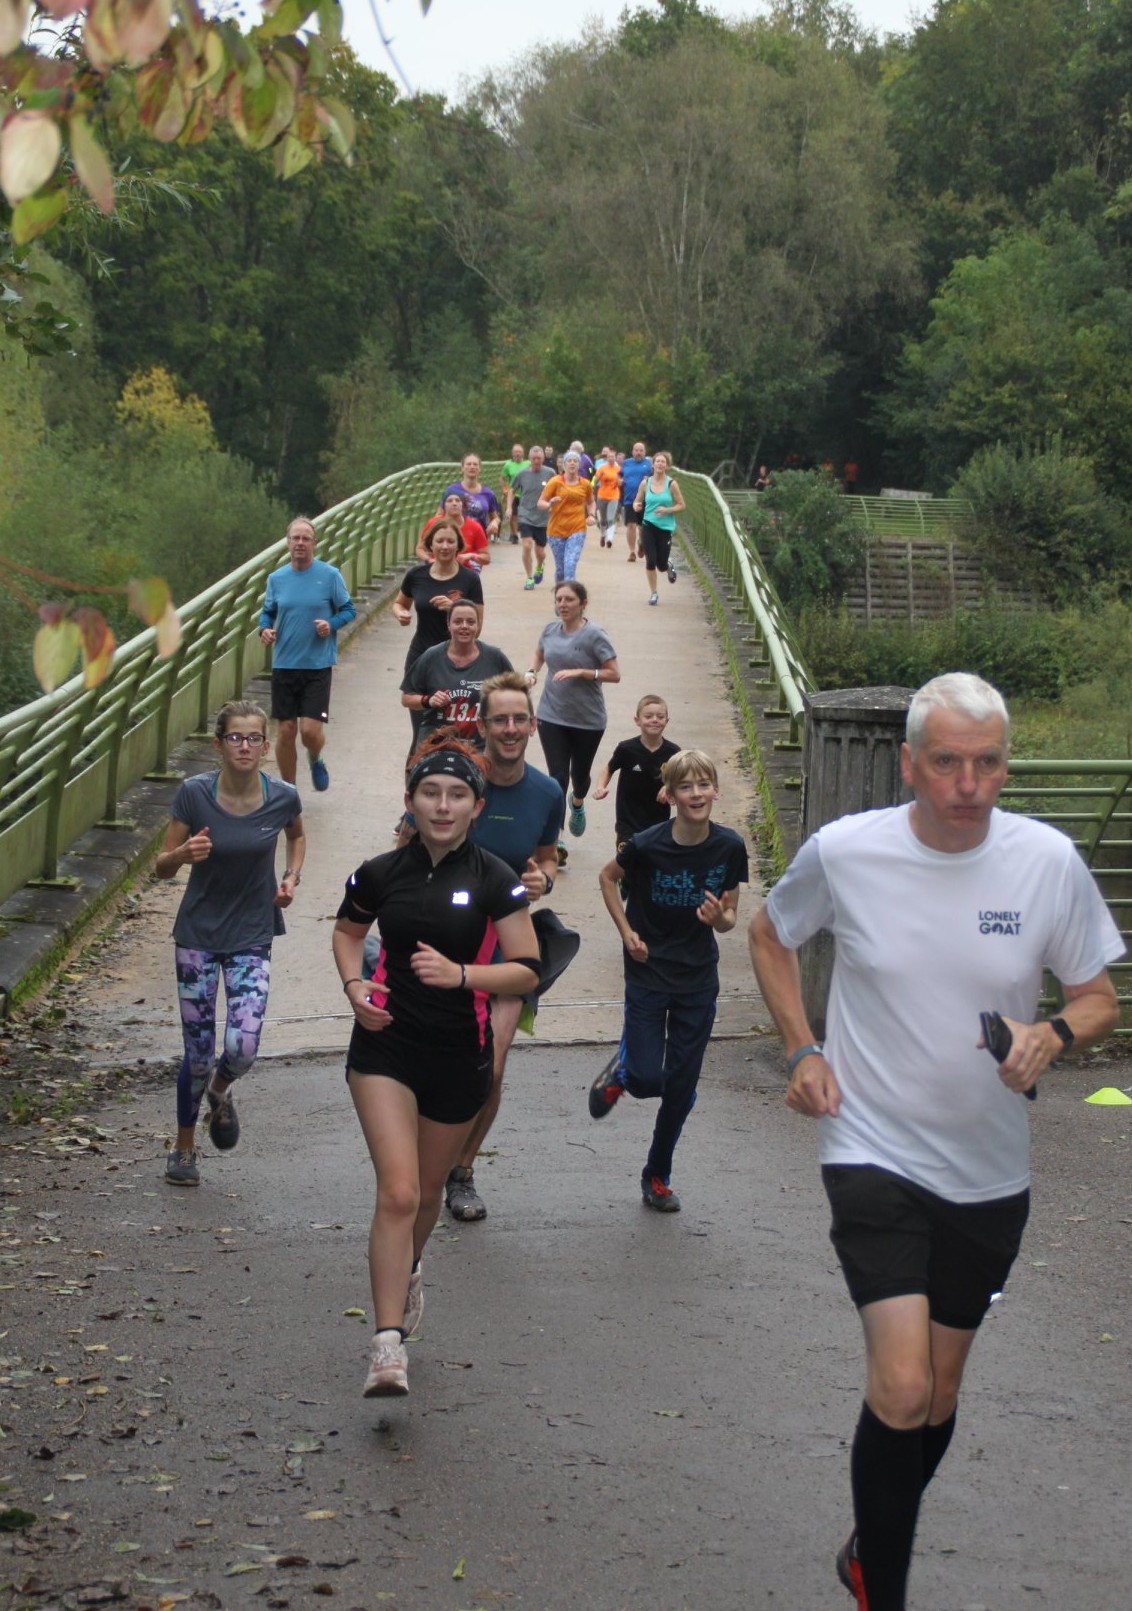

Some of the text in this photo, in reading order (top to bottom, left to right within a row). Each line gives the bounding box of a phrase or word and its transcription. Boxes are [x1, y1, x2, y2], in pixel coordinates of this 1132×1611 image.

[448, 690, 471, 699] EATEST
[978, 911, 1020, 921] LONELY
[979, 922, 1021, 935] GOAT
